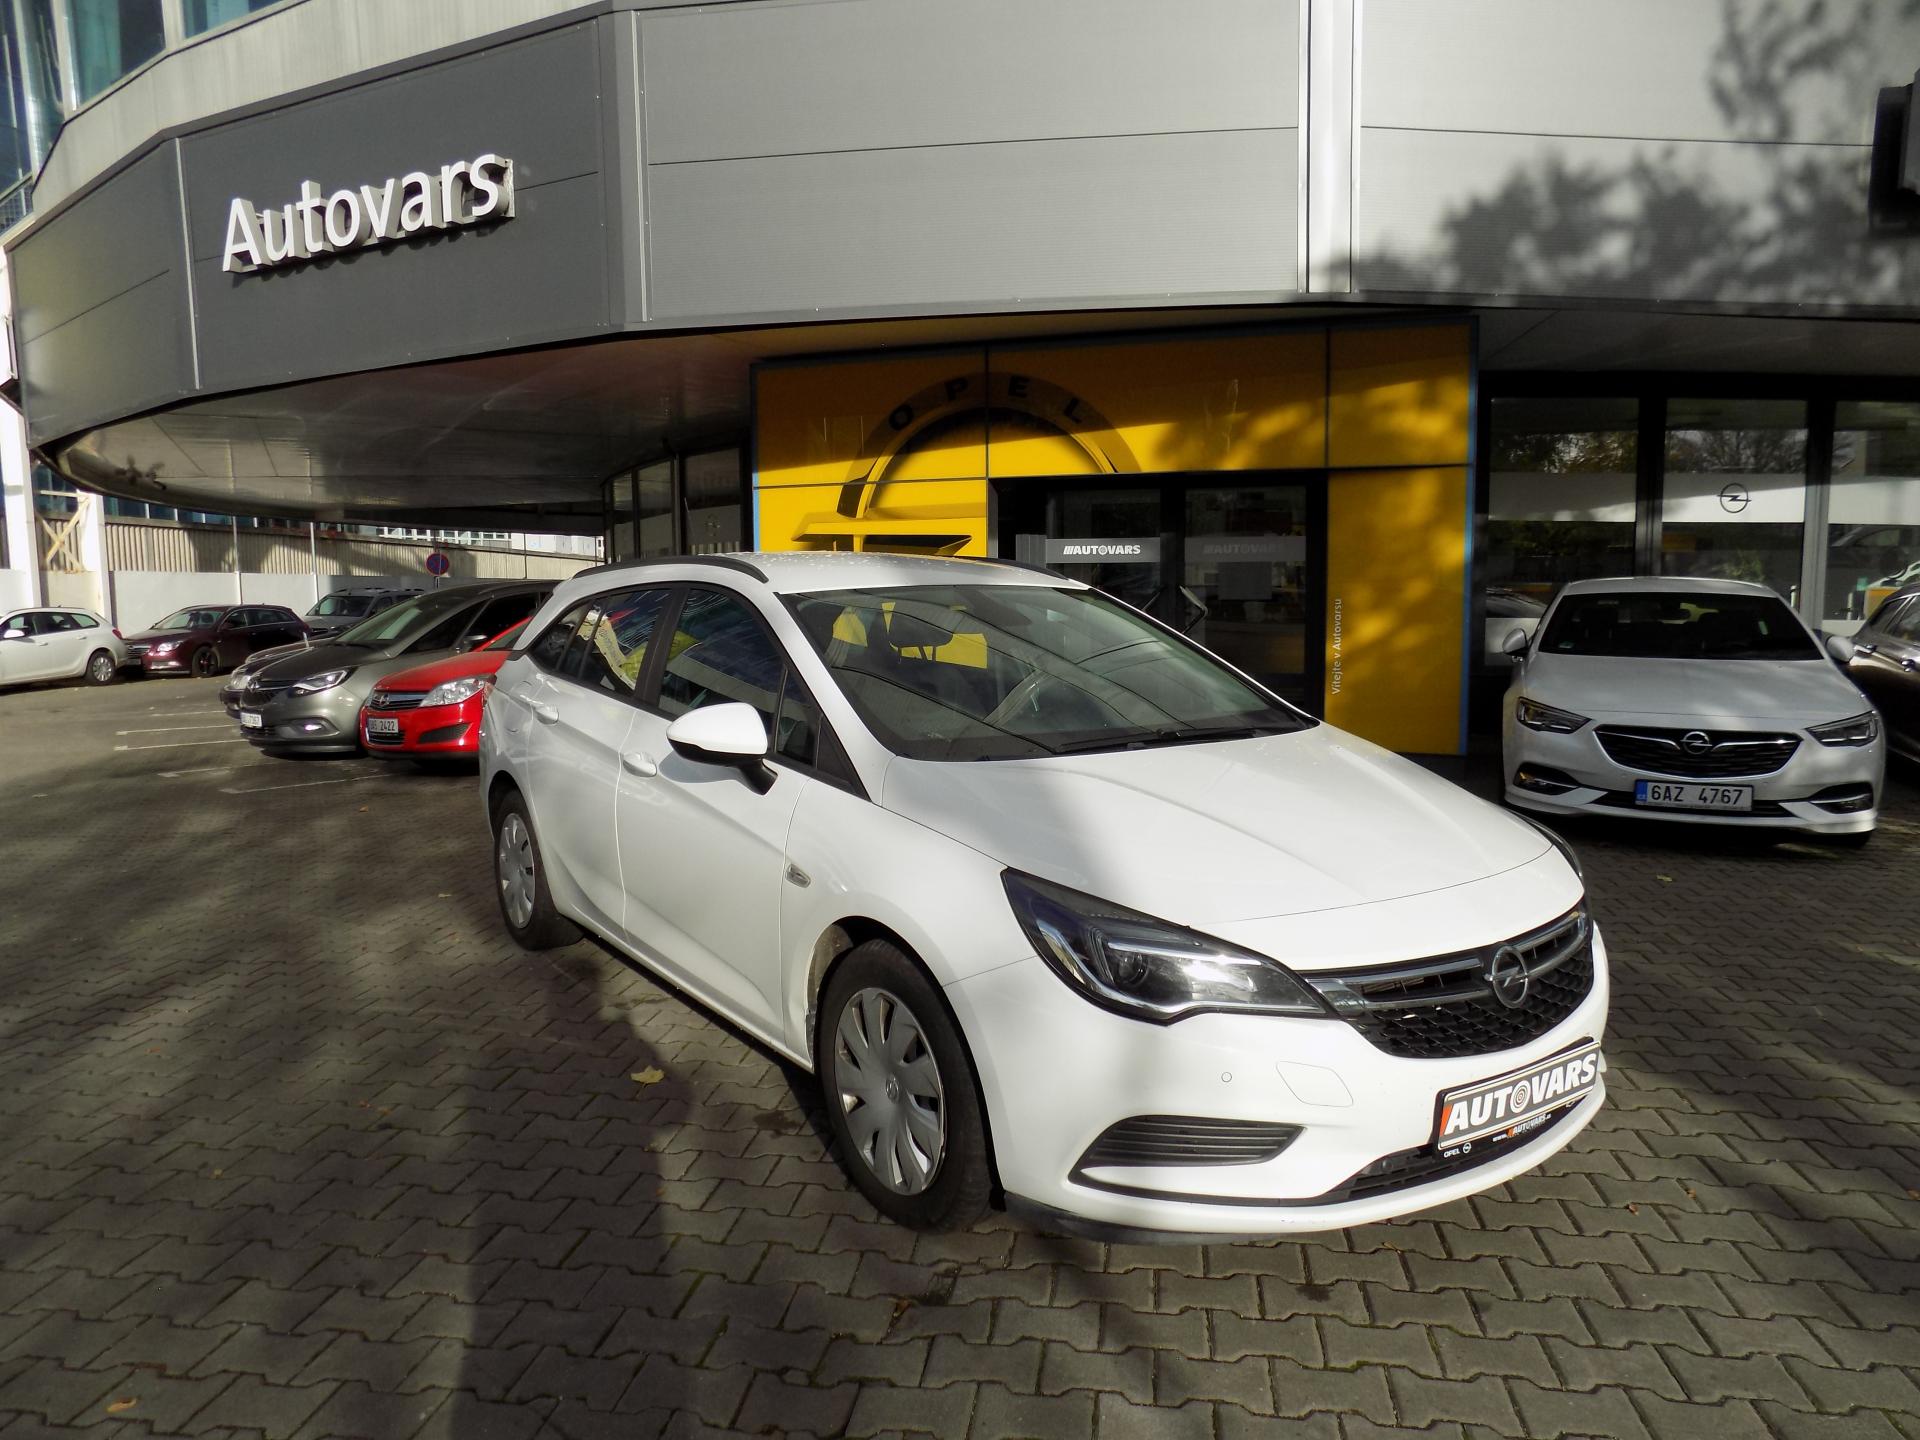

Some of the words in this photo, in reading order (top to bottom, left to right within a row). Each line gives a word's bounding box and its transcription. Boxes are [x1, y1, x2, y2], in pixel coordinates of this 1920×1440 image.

[222, 153, 508, 272] Autovars
[888, 374, 1083, 432] OPEL
[1073, 544, 1141, 556] AUTOVARS
[1332, 599, 1343, 651] Autovarsu
[1651, 785, 1684, 802] 6AZ
[1698, 787, 1743, 805] 4767
[1443, 1053, 1597, 1136] AUTOVARS
[1443, 1148, 1461, 1158] OPEL
